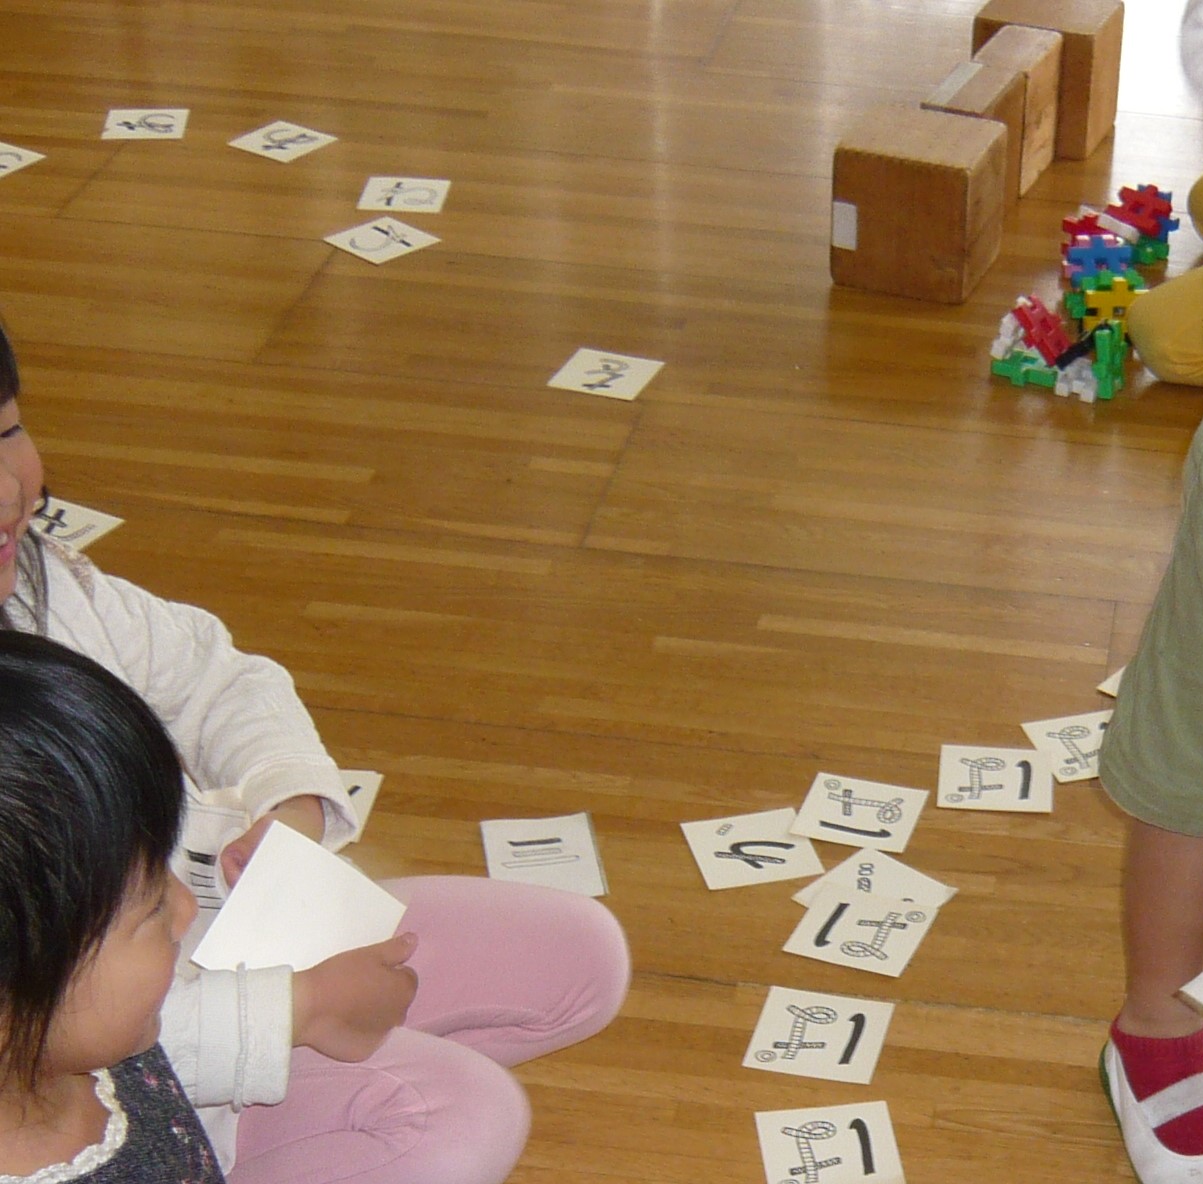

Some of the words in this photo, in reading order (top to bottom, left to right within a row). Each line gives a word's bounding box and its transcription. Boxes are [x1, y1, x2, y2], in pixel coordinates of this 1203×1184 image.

[819, 779, 905, 839] ぱ
[946, 757, 1032, 804] ぱ
[715, 822, 797, 869] か
[815, 902, 926, 960] ぱ
[755, 1005, 865, 1064] ぱ
